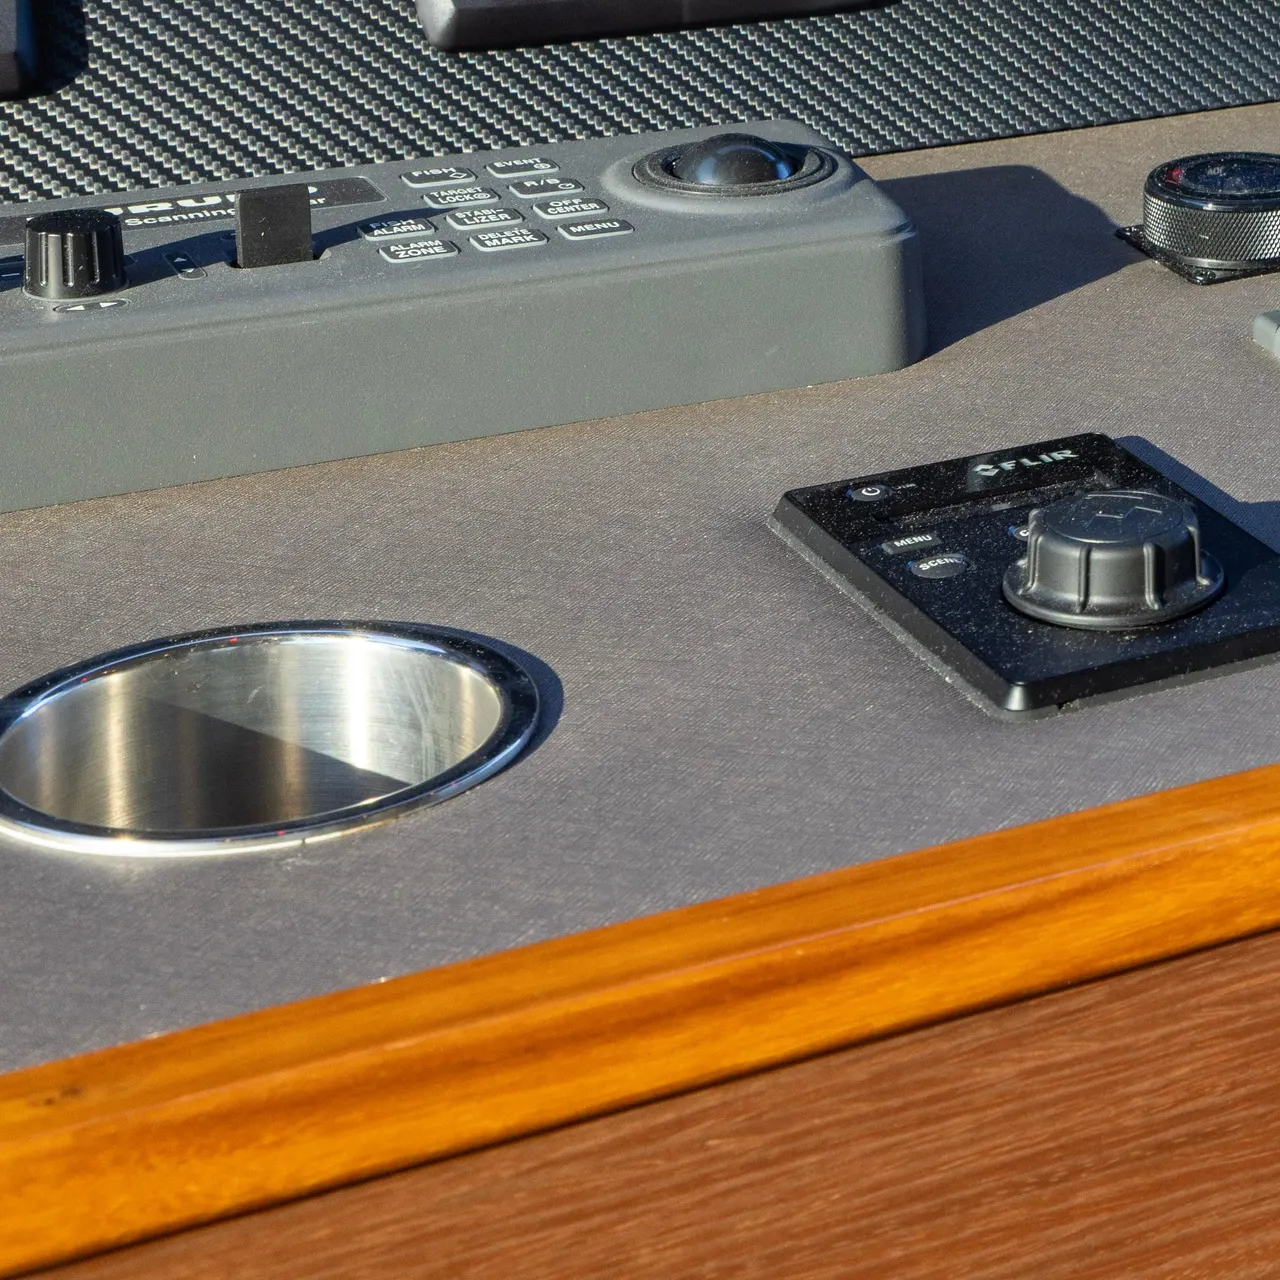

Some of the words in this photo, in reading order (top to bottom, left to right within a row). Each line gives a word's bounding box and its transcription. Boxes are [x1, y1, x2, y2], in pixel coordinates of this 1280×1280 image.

[494, 157, 542, 169] EVENT
[412, 167, 457, 177] FISH
[430, 186, 483, 198] TARGET
[438, 194, 474, 205] LOCK
[550, 198, 583, 208] OFF
[455, 209, 506, 220] STABI-
[547, 203, 600, 215] CENTER
[124, 207, 236, 227] Scanning
[463, 213, 512, 225] LIZER
[370, 219, 416, 230] FISH
[373, 223, 426, 236] ALARM
[570, 221, 620, 234] MENU
[478, 229, 531, 241] DELETE
[485, 234, 539, 248] MARK
[390, 240, 443, 252] ALARM
[396, 246, 448, 259] ZONE
[998, 449, 1080, 472] FLIR
[893, 534, 933, 548] MENU
